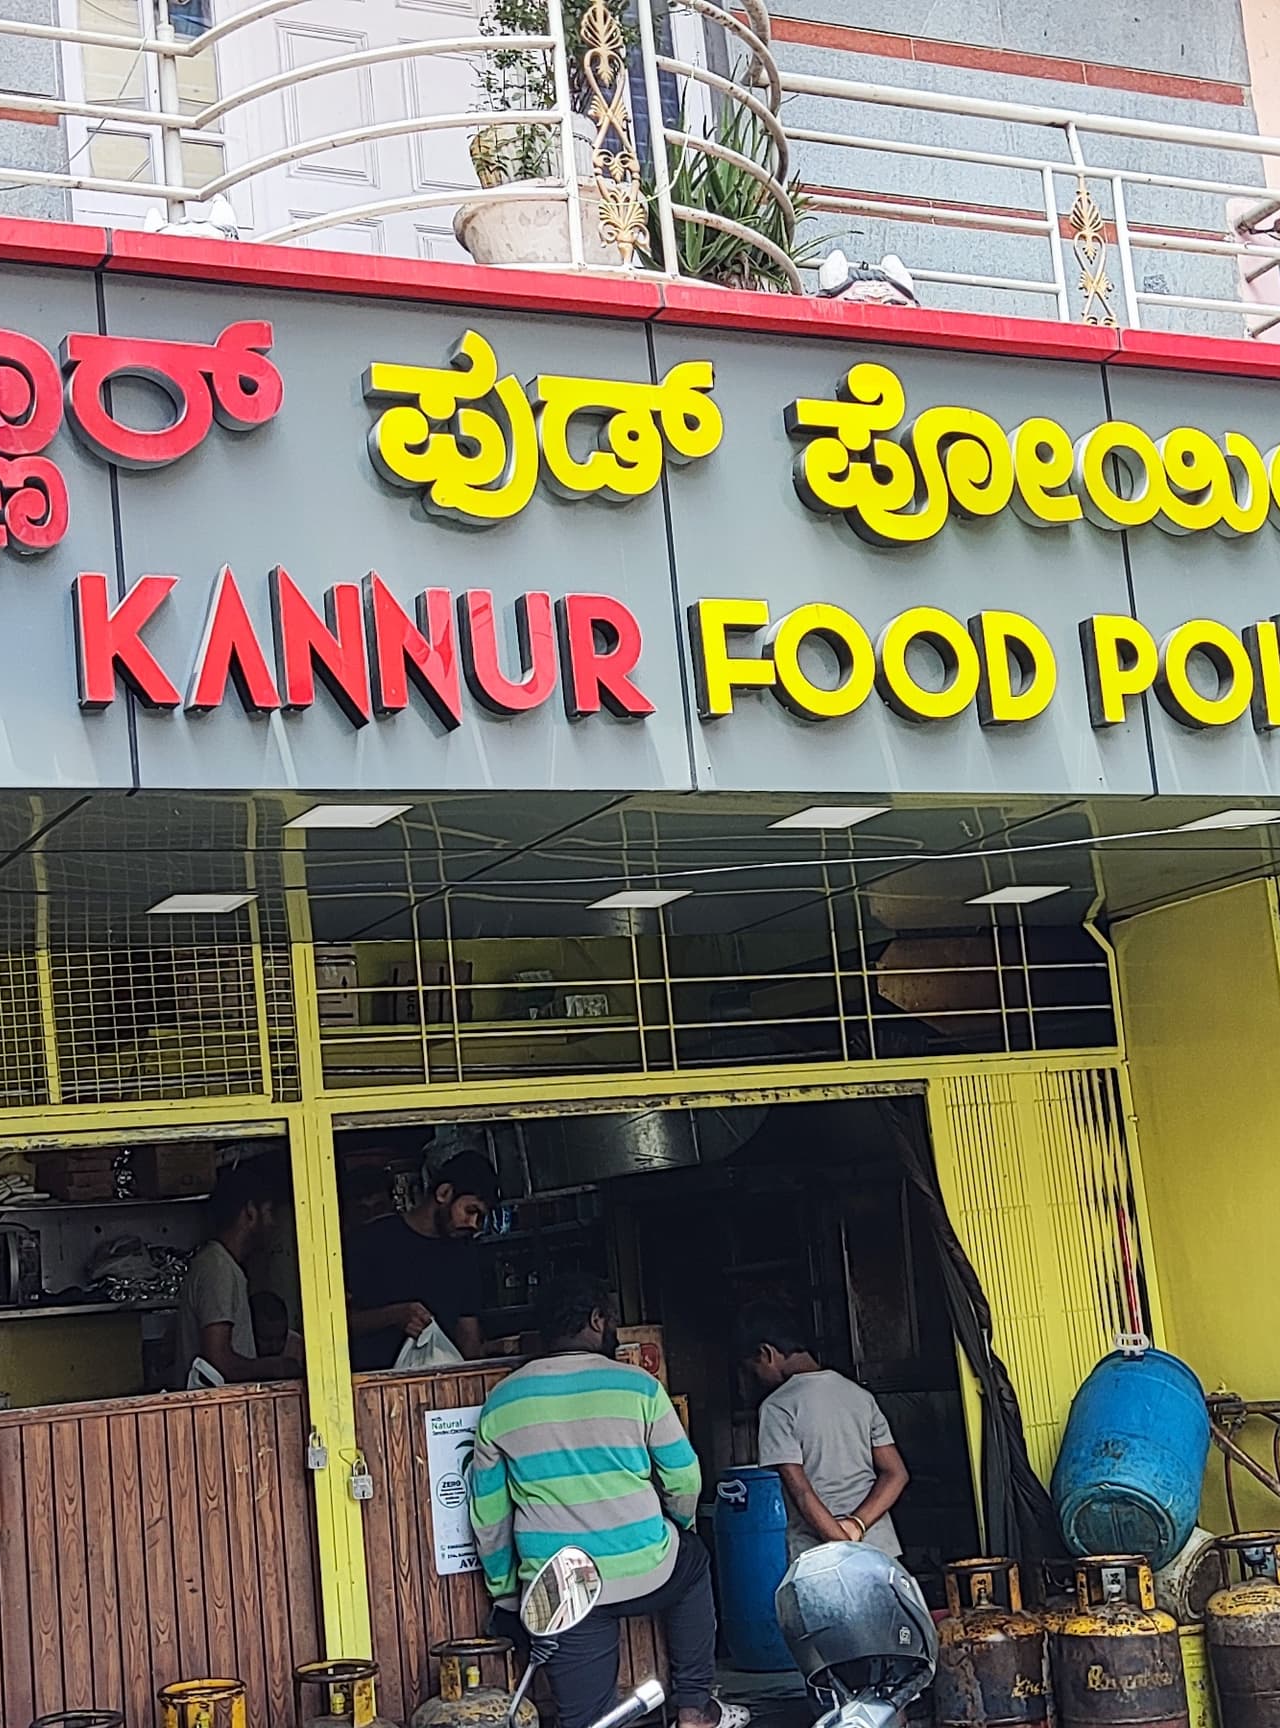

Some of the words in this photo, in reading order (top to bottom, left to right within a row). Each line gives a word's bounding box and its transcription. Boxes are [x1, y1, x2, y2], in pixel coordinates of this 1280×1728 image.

[73, 565, 655, 731] KANNUR
[690, 598, 1057, 723] FOOD
[432, 1419, 463, 1430] Natural
[441, 1480, 461, 1489] ZERO
